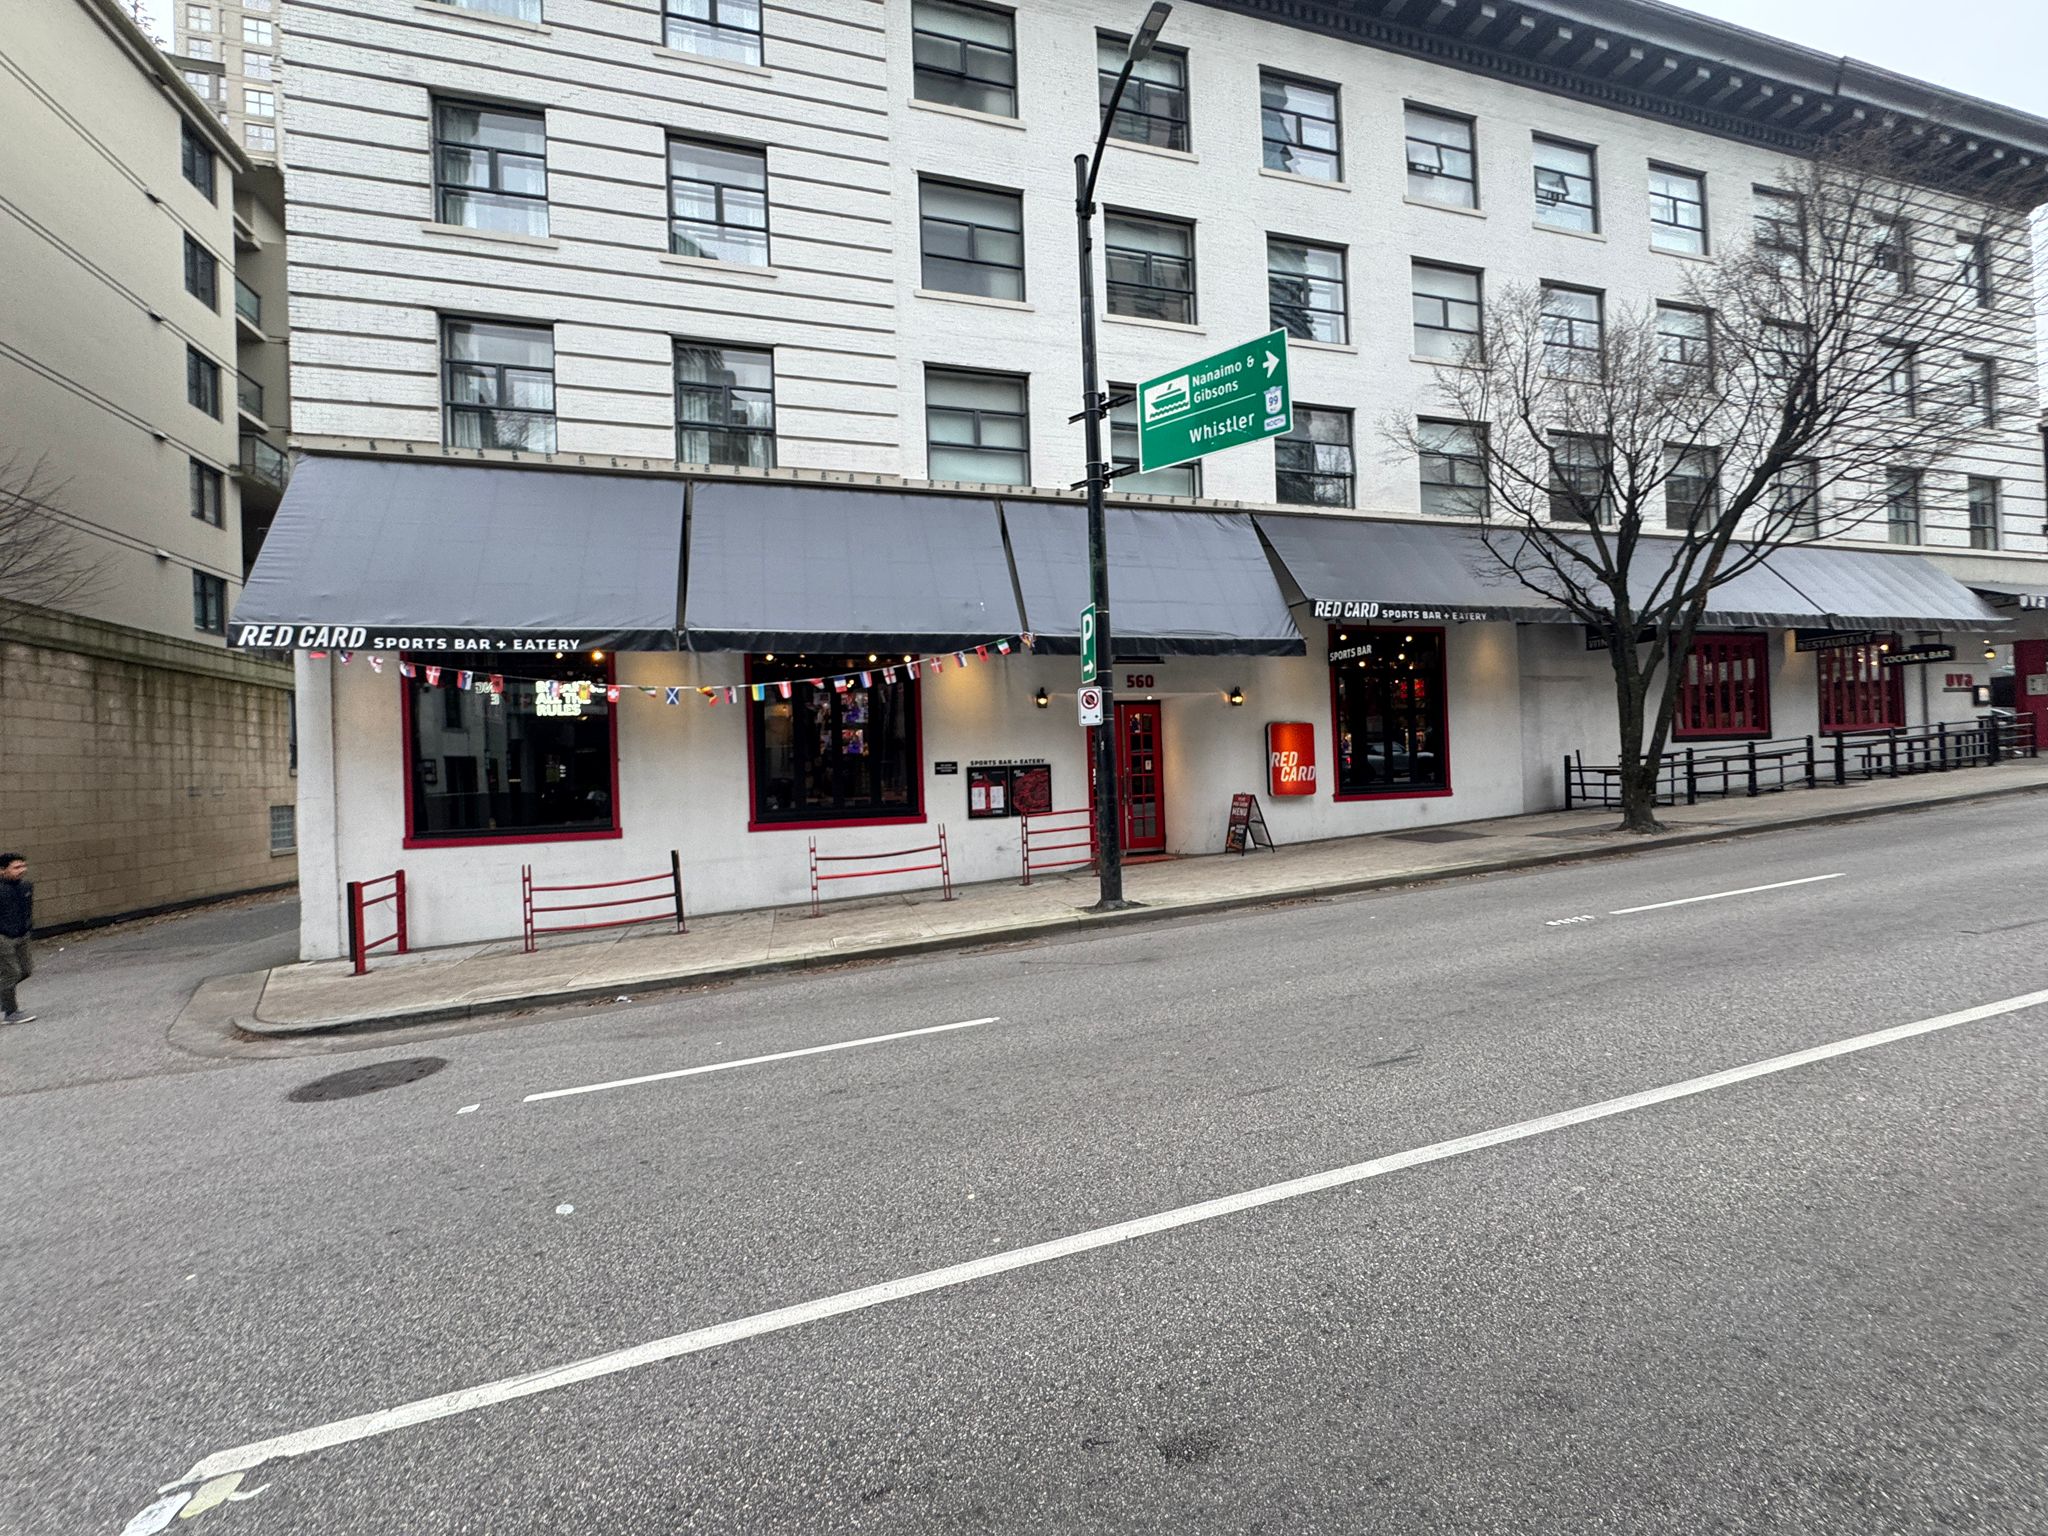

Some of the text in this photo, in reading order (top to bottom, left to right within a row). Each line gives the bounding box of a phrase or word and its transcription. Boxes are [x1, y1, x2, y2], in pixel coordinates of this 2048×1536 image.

[1192, 355, 1255, 387] Nanaimo &
[1193, 380, 1239, 404] Gibsons
[1268, 395, 1279, 407] 99
[1189, 413, 1255, 443] Whistler
[1314, 601, 1342, 617] RED
[1344, 602, 1379, 618] CARD
[1382, 610, 1419, 619] SPORTS
[1422, 611, 1441, 620] BAR
[1452, 611, 1487, 621] EATERY
[237, 625, 580, 650] RED CARD SPORTS BAR + EATERY
[1082, 613, 1093, 656] P
[1329, 644, 1373, 662] SPORTS BAR
[1882, 650, 1950, 664] COCKTAIL BAR
[1126, 674, 1154, 688] 560
[536, 704, 581, 717] RULES
[1271, 751, 1299, 767] RED
[1281, 765, 1316, 782] CARD
